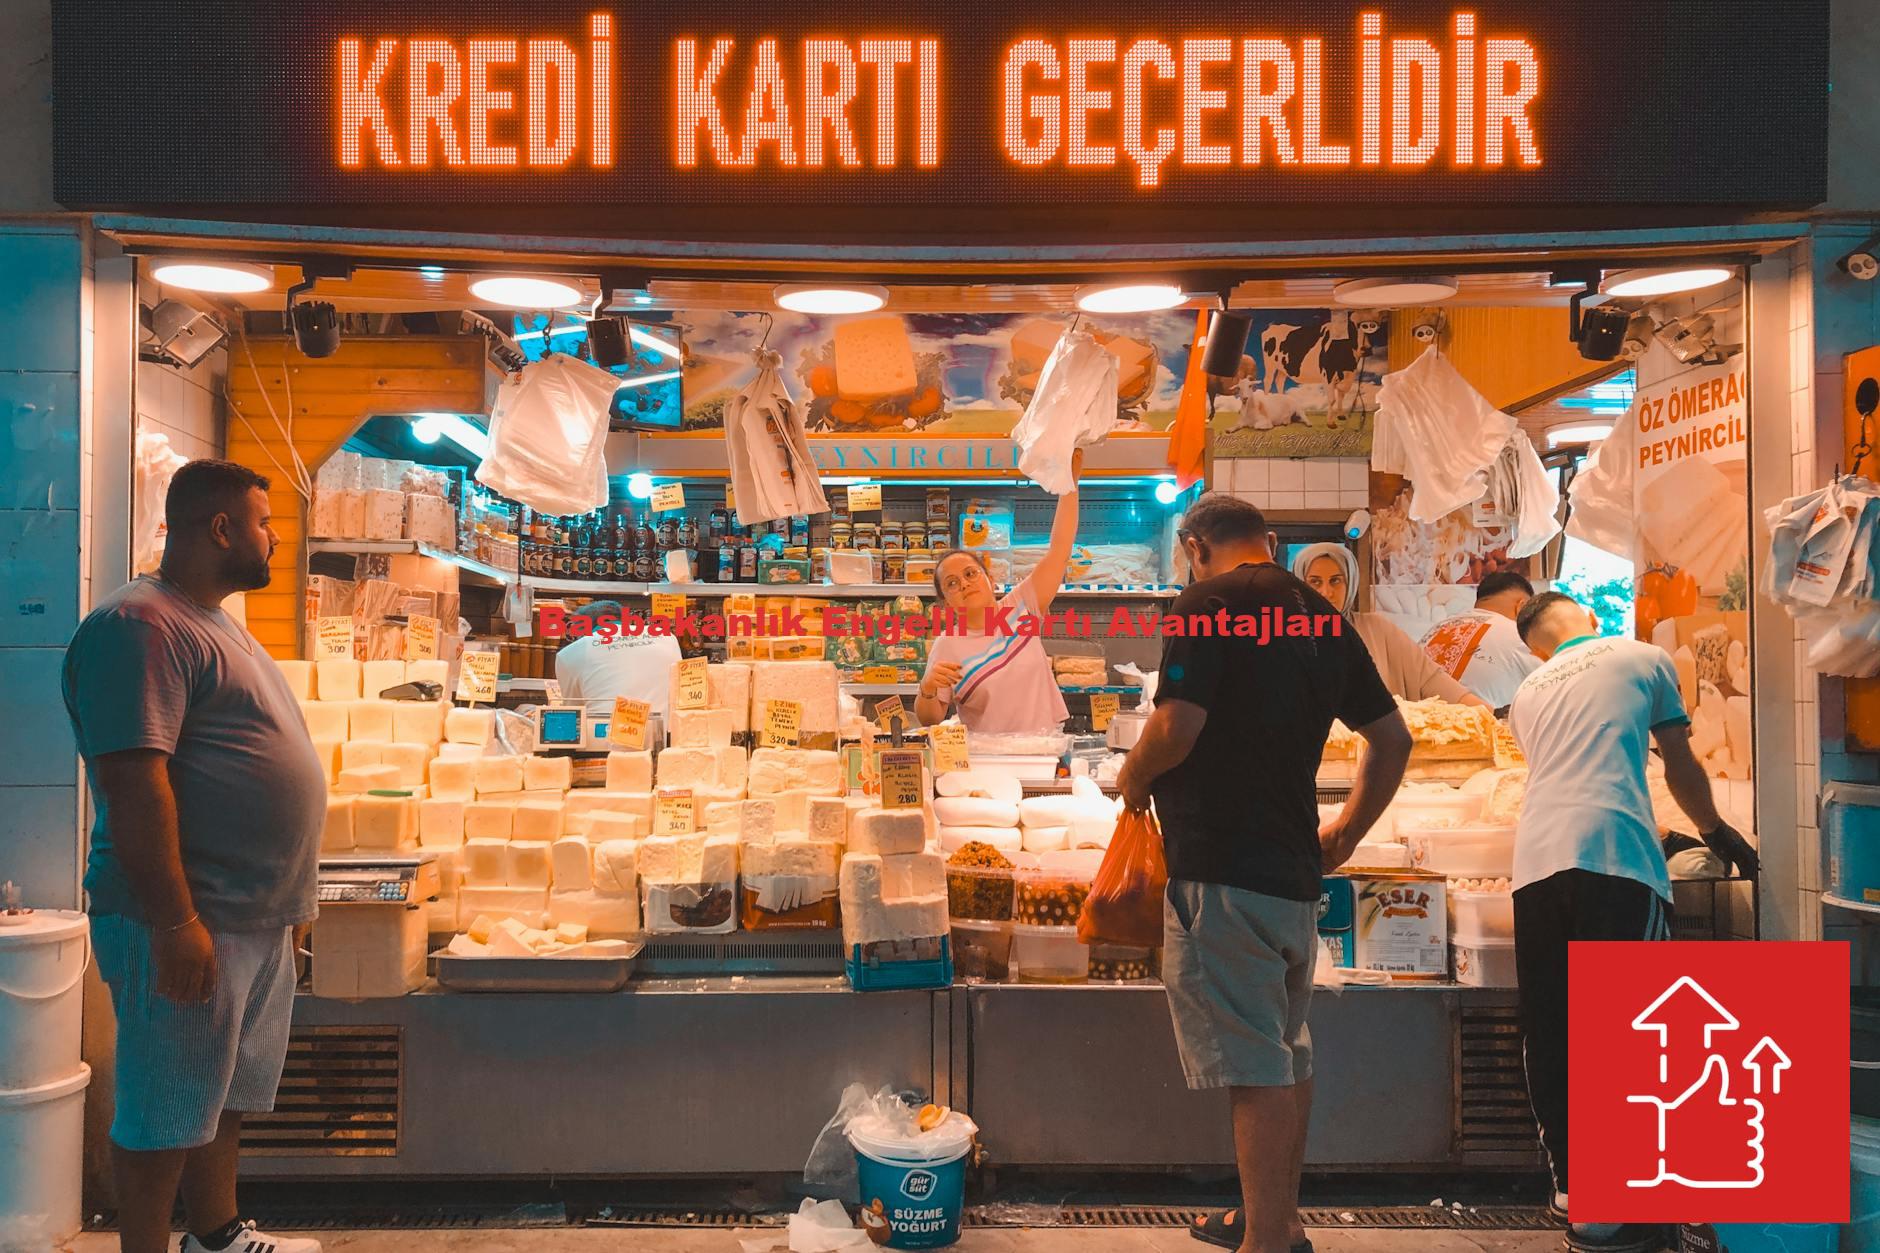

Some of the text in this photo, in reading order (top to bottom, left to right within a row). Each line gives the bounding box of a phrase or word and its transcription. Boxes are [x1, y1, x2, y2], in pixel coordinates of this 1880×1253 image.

[338, 12, 1541, 187] KREDİ KARTI GEÇERLİDİR
[1639, 396, 1664, 433] ÖZ
[1639, 414, 1745, 469] PEYNİRCİL
[770, 735, 786, 744] 320
[899, 794, 917, 803] 280
[1376, 888, 1431, 909] ESER
[910, 1176, 930, 1186] gür
[909, 1184, 928, 1193] süt
[894, 1207, 943, 1221] SÜZME
[890, 1219, 947, 1233] YOĞURT
